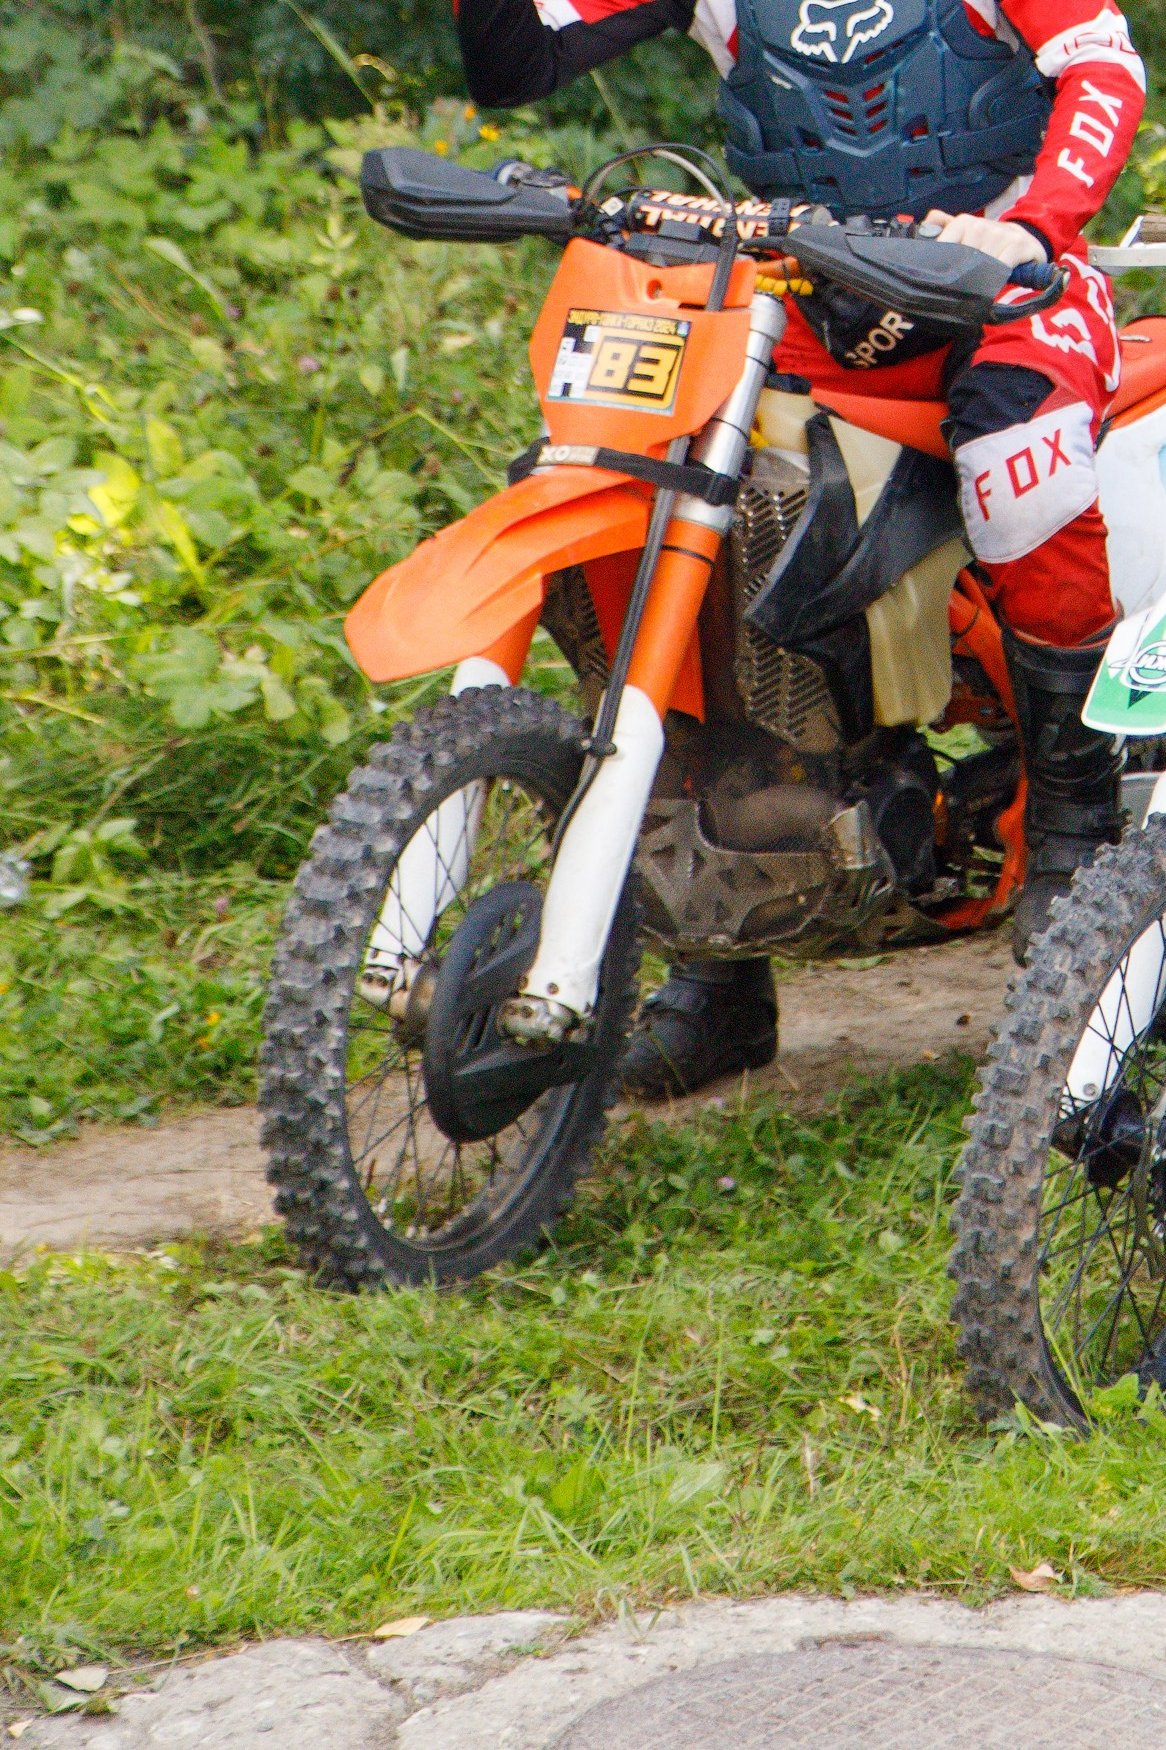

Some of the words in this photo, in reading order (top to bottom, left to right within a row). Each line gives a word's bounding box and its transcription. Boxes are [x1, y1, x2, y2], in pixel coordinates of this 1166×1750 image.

[1057, 79, 1123, 189] FOX
[589, 341, 679, 396] 83
[973, 428, 1072, 523] FOX
